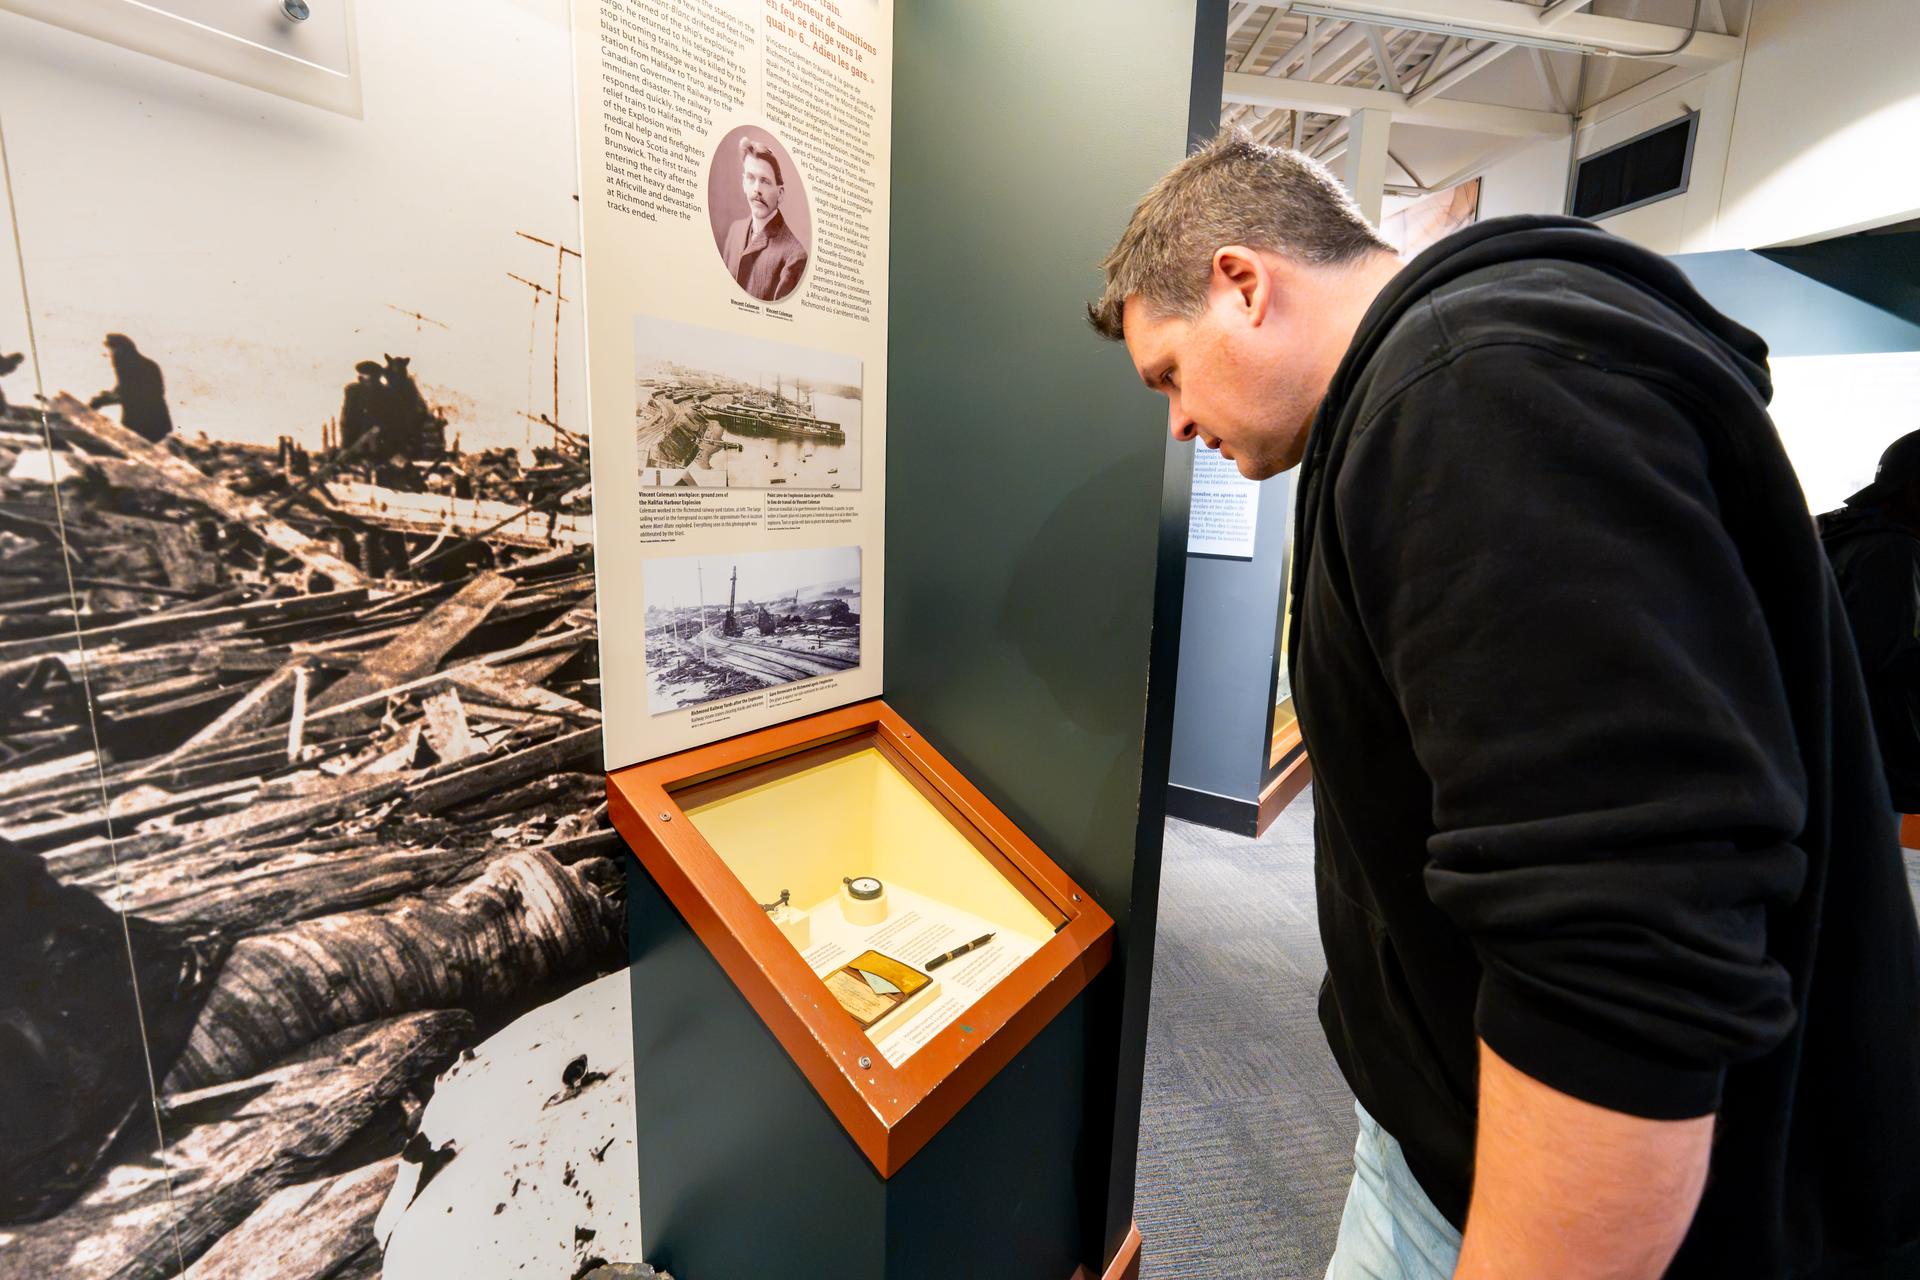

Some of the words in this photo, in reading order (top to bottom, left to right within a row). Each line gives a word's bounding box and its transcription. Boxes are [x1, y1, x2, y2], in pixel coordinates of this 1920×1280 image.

[670, 17, 682, 29] the
[691, 17, 715, 34] drifted
[716, 31, 737, 47] ashore
[697, 6, 726, 29] hundred
[740, 31, 754, 45] from
[714, 6, 736, 23] station
[745, 24, 755, 34] the
[780, 3, 795, 22] feu
[797, 17, 807, 29] se
[809, 22, 834, 45] dirige
[836, 40, 853, 57] vers
[855, 49, 863, 63] le
[826, 15, 835, 30] de
[837, 25, 876, 56] munitions
[600, 8, 618, 22] stop
[620, 15, 656, 43] incoming
[682, 46, 692, 58] He
[693, 54, 706, 66] was
[708, 59, 726, 75] killed
[726, 69, 735, 81] by
[736, 75, 747, 86] the
[600, 18, 620, 36] blast
[622, 29, 636, 44] but
[637, 37, 649, 50] his
[650, 45, 682, 66] message
[684, 62, 697, 73] was
[699, 66, 718, 83] heard
[719, 77, 727, 89] by
[729, 84, 745, 98] every
[638, 13, 671, 35] returned
[682, 34, 692, 47] his
[694, 42, 726, 63] telegraph
[727, 58, 737, 71] key
[766, 15, 786, 33] quai
[812, 41, 836, 63] Adieu
[838, 54, 849, 70] les
[601, 34, 629, 52] station
[630, 46, 649, 62] from
[650, 56, 676, 74] Halifax
[677, 70, 686, 79] to
[734, 97, 744, 106] the
[601, 45, 638, 69] Canadian
[640, 64, 685, 91] Government
[687, 84, 712, 105] Railway
[713, 98, 720, 107] to
[722, 102, 732, 112] the
[602, 58, 640, 83] imminent
[673, 90, 686, 103] The
[687, 99, 711, 116] railway
[602, 74, 644, 97] responded
[675, 105, 702, 124] sending
[704, 118, 712, 126] six
[603, 87, 623, 100] relief
[624, 95, 646, 110] trains
[648, 105, 656, 114] to
[657, 108, 682, 125] Halifax
[683, 120, 695, 130] the
[696, 125, 708, 137] day
[603, 100, 612, 108] of
[613, 102, 627, 114] the
[628, 108, 664, 129] Explosion
[666, 125, 682, 136] with
[604, 113, 634, 129] medical
[636, 123, 652, 138] help
[653, 132, 668, 143] and
[669, 136, 705, 158] firefighters
[604, 123, 623, 138] from
[625, 132, 645, 146] Nova
[646, 140, 668, 155] Scotia
[670, 151, 683, 161] and
[684, 154, 700, 167] New
[605, 151, 638, 170] entering
[640, 162, 653, 173] the
[654, 168, 667, 180] city
[668, 173, 685, 184] after
[686, 179, 698, 189] the
[606, 162, 625, 176] blast
[626, 171, 642, 181] met
[643, 174, 665, 190] heavy
[666, 183, 694, 199] damage
[647, 152, 661, 164] The
[662, 157, 676, 170] first
[678, 164, 696, 177] trains
[606, 176, 614, 184] at
[616, 178, 647, 195] Africville
[648, 190, 662, 200] and
[663, 194, 702, 213] devastation
[607, 189, 614, 197] at
[616, 190, 655, 209] Richmond
[656, 204, 678, 216] where
[679, 211, 691, 221] the
[607, 200, 630, 214] tracks
[691, 708, 709, 716] Richmond
